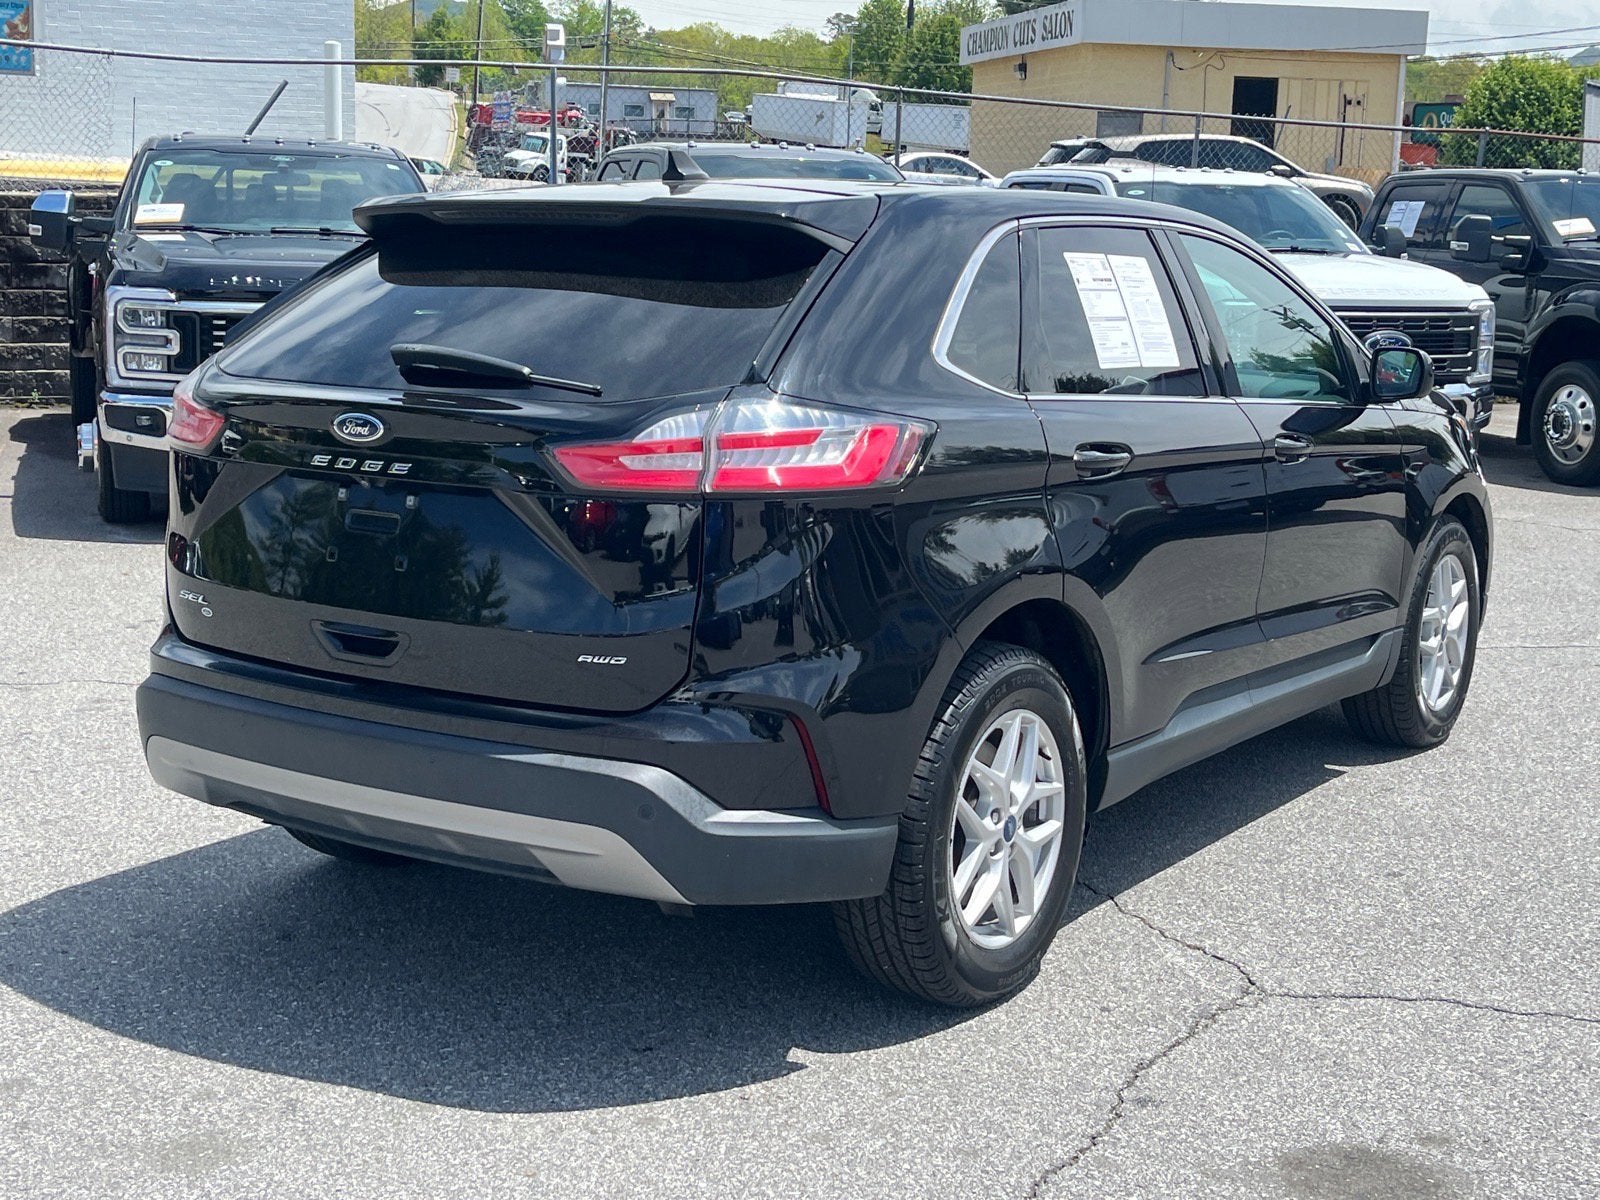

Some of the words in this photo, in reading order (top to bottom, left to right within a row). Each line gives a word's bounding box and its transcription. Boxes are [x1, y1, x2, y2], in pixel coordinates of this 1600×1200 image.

[967, 24, 1010, 56] CHAMPION
[1013, 18, 1037, 48] CUTS
[1041, 9, 1075, 42] SALON
[342, 418, 371, 436] Ford
[310, 454, 412, 475] EDGE
[179, 589, 209, 605] SEL
[577, 654, 628, 665] AWD
